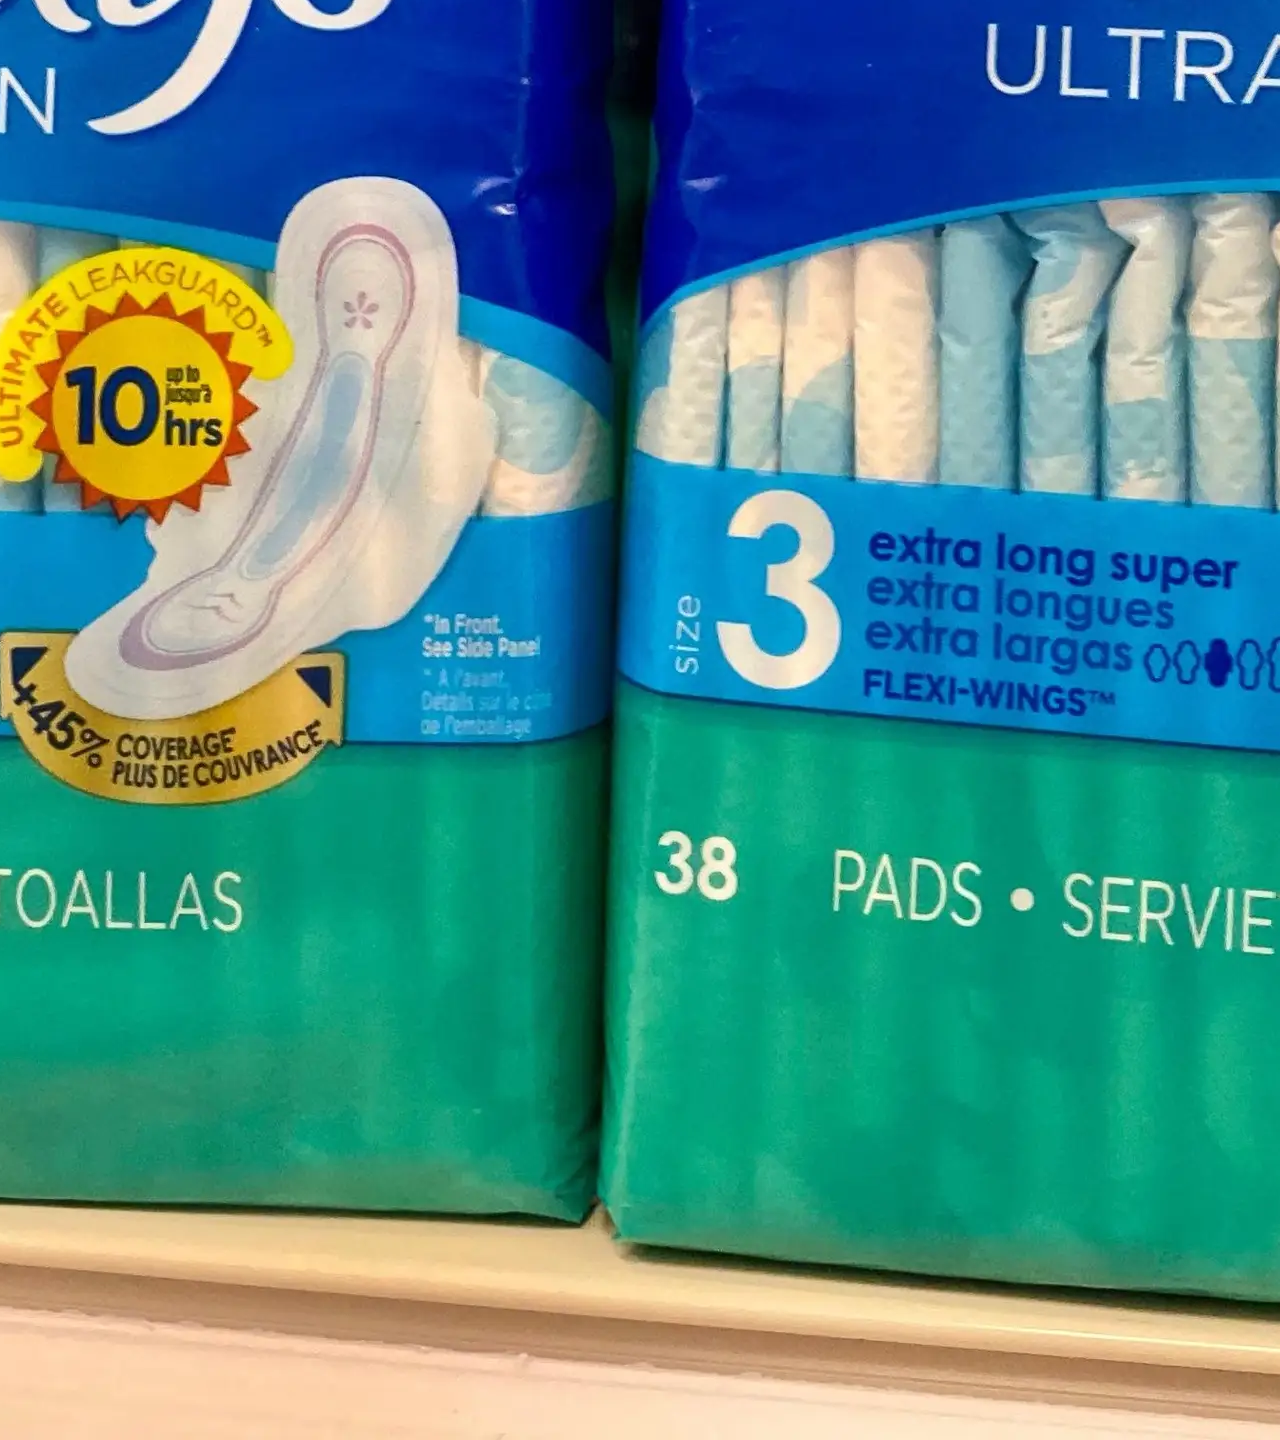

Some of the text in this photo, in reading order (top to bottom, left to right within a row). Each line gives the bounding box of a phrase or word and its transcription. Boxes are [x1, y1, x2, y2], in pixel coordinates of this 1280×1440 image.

[65, 365, 161, 446] 10
[187, 364, 200, 382] to
[165, 410, 222, 446] hrs
[716, 489, 842, 690] 3
[868, 527, 1239, 593] extra long super
[675, 595, 701, 674] size
[867, 571, 1175, 632] extra longues
[422, 635, 541, 658] See Side Panel
[865, 617, 1132, 675] extra largas
[13, 681, 237, 769] +45% COVERAGE
[111, 720, 323, 788] PLUS DE COUVRANCE
[652, 829, 740, 901] 38
[832, 848, 984, 929] PADS
